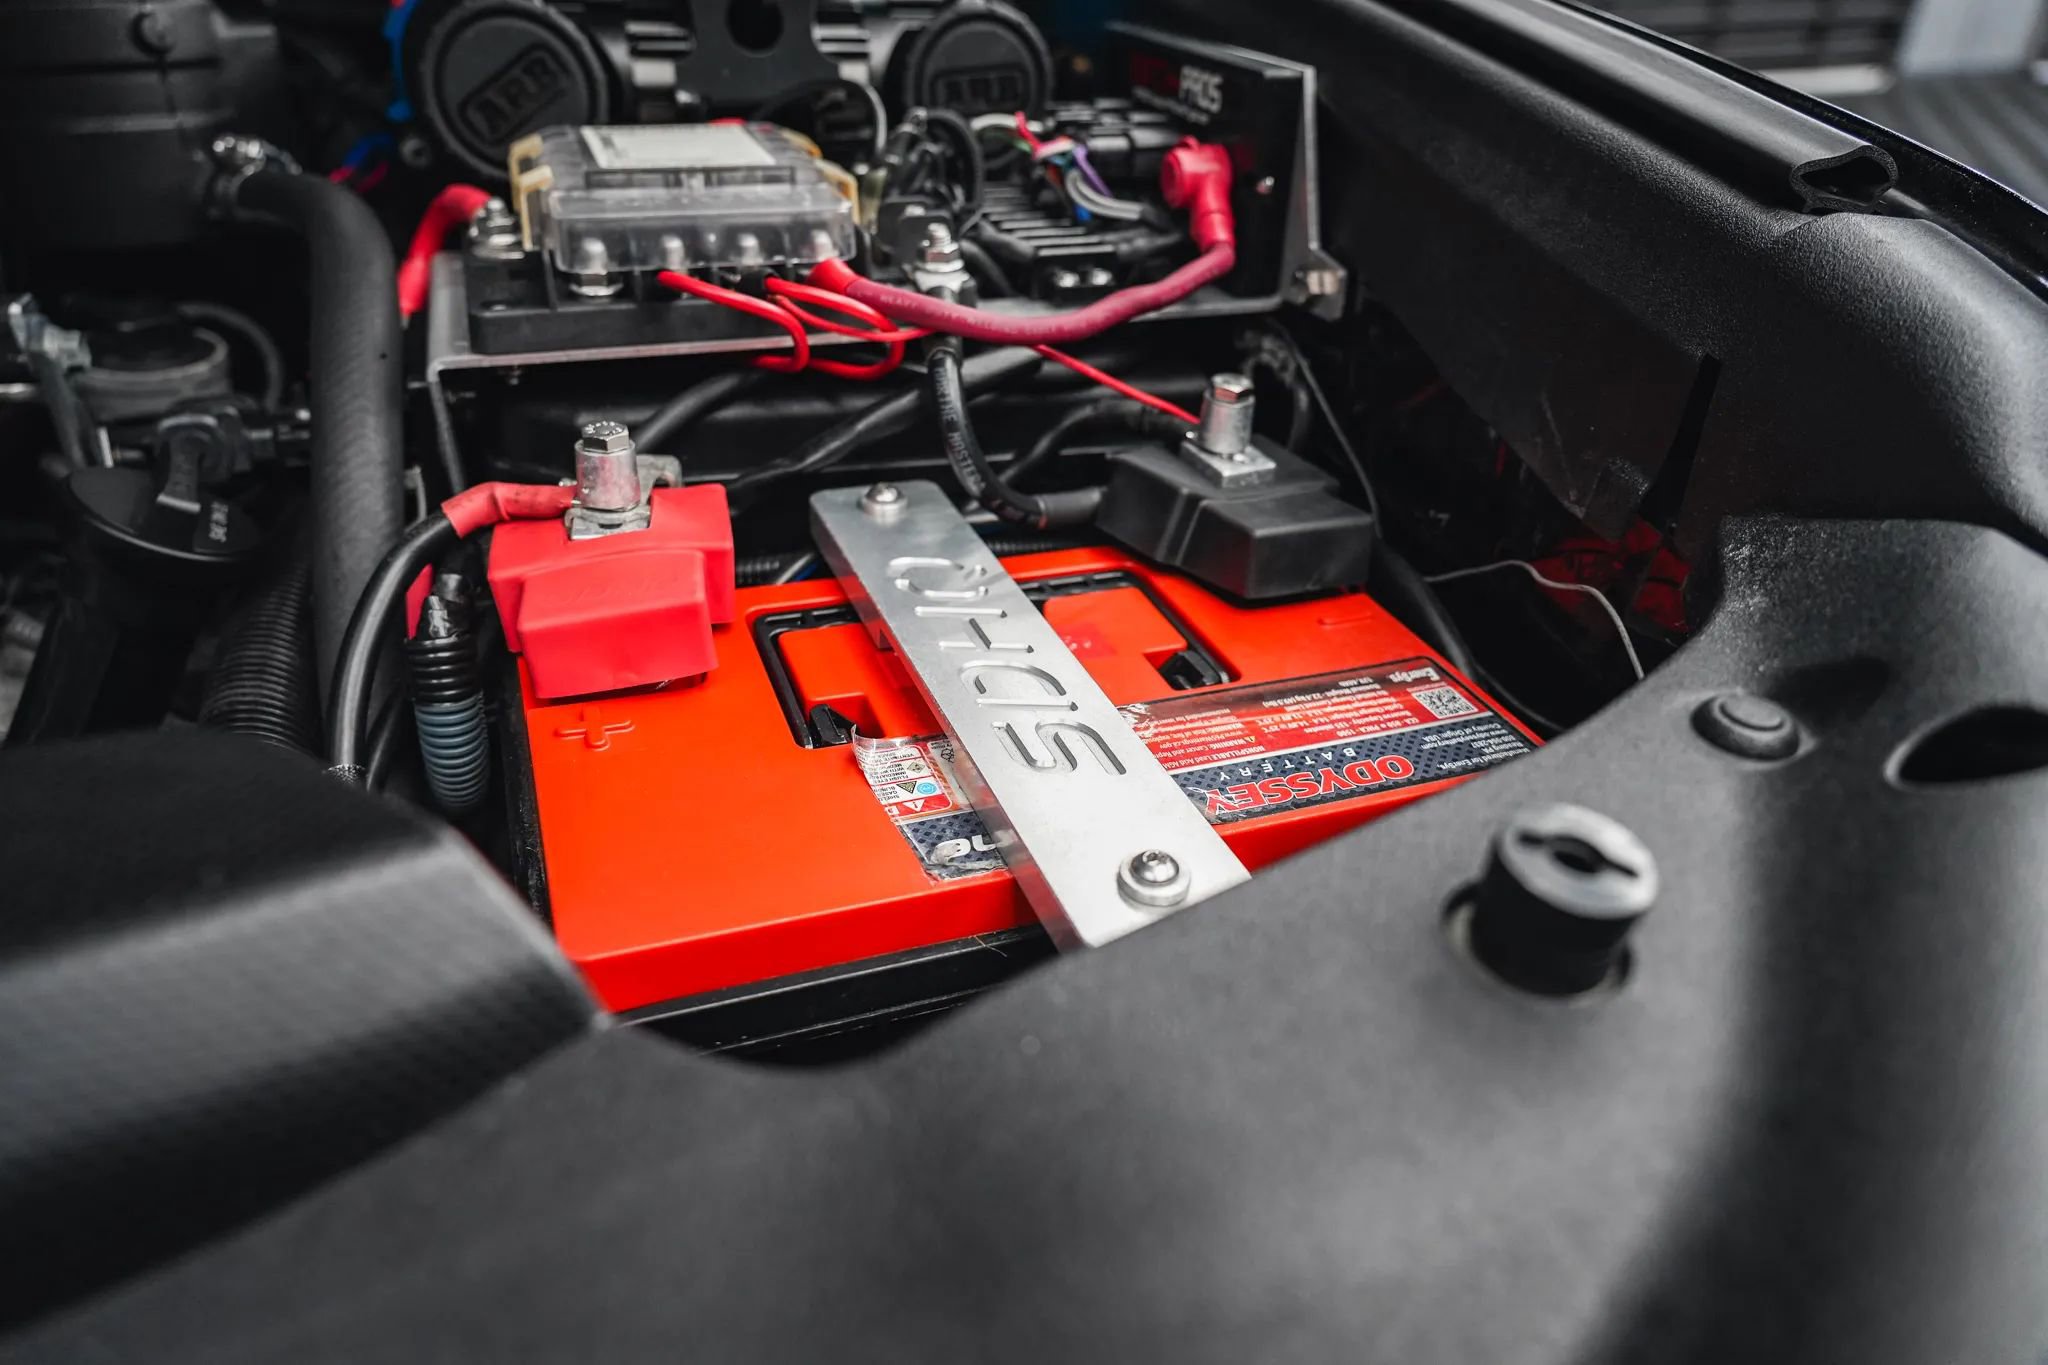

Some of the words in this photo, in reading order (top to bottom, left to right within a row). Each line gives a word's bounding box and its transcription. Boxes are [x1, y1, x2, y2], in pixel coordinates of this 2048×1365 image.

[1185, 745, 1209, 753] Cancer
[1209, 738, 1246, 749] WARNING:
[1211, 746, 1265, 760] NONSPILLABLE
[1179, 758, 1194, 766] Acid
[1194, 755, 1212, 763] Lead
[1219, 746, 1356, 781] BATTERY
[1205, 755, 1414, 815] ODYSSEY
